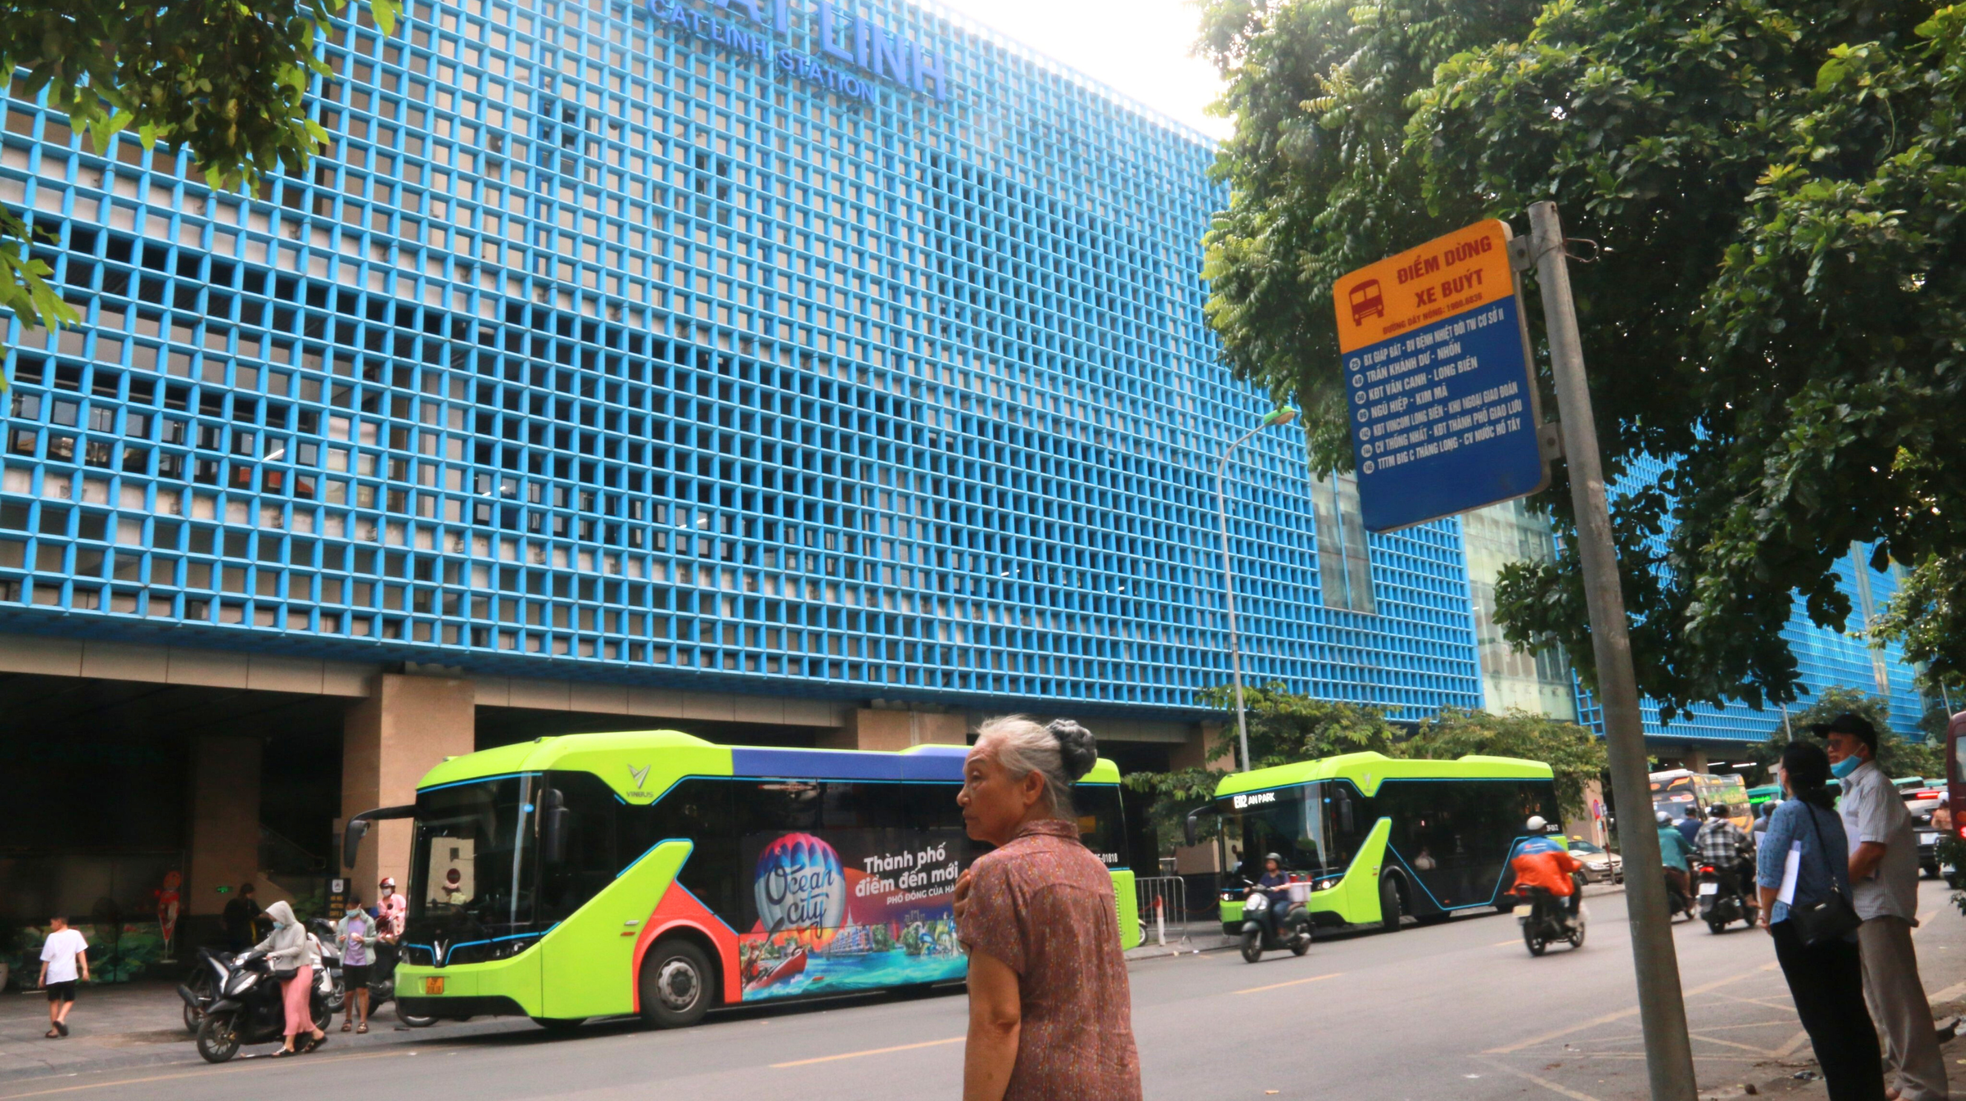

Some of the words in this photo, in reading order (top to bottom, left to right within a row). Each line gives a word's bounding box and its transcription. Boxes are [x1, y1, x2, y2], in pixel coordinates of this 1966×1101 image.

[648, 0, 703, 32] CAT
[709, 19, 767, 61] LINH
[777, 49, 876, 104] STATION
[818, 0, 946, 101] LINH
[1397, 254, 1440, 285] ĐIỂM
[1445, 235, 1492, 267] DỪNG
[1414, 286, 1436, 308] XE
[1441, 268, 1484, 300] BUÝT
[1466, 318, 1477, 332] TW
[1368, 386, 1384, 401] KĐT
[1404, 372, 1427, 390] CANH
[1433, 363, 1456, 381] LONG
[1457, 355, 1478, 373] BIÊN
[1389, 358, 1417, 376] KHÁNH
[1418, 351, 1430, 366] DƯ
[1389, 396, 1408, 413] HIỆP
[1415, 390, 1432, 406] KIM
[1411, 410, 1428, 425] LONG
[1375, 441, 1384, 454] CV
[1433, 422, 1447, 437] KĐT
[1489, 404, 1507, 420] GIAO
[1378, 455, 1396, 470] TTTM
[1396, 451, 1409, 465] BIG
[1409, 449, 1415, 461] C
[1439, 436, 1459, 452] LONG
[1464, 432, 1473, 445] CV
[1258, 792, 1276, 803] PARK
[863, 850, 913, 874] Thành
[917, 841, 946, 869] phố
[765, 863, 836, 906] Ocean
[855, 874, 895, 898] điểm
[899, 866, 927, 889] đến
[931, 861, 959, 883] mới
[904, 888, 927, 902] ĐÔNG
[928, 885, 944, 897] CỦA
[944, 882, 956, 893] HÀ
